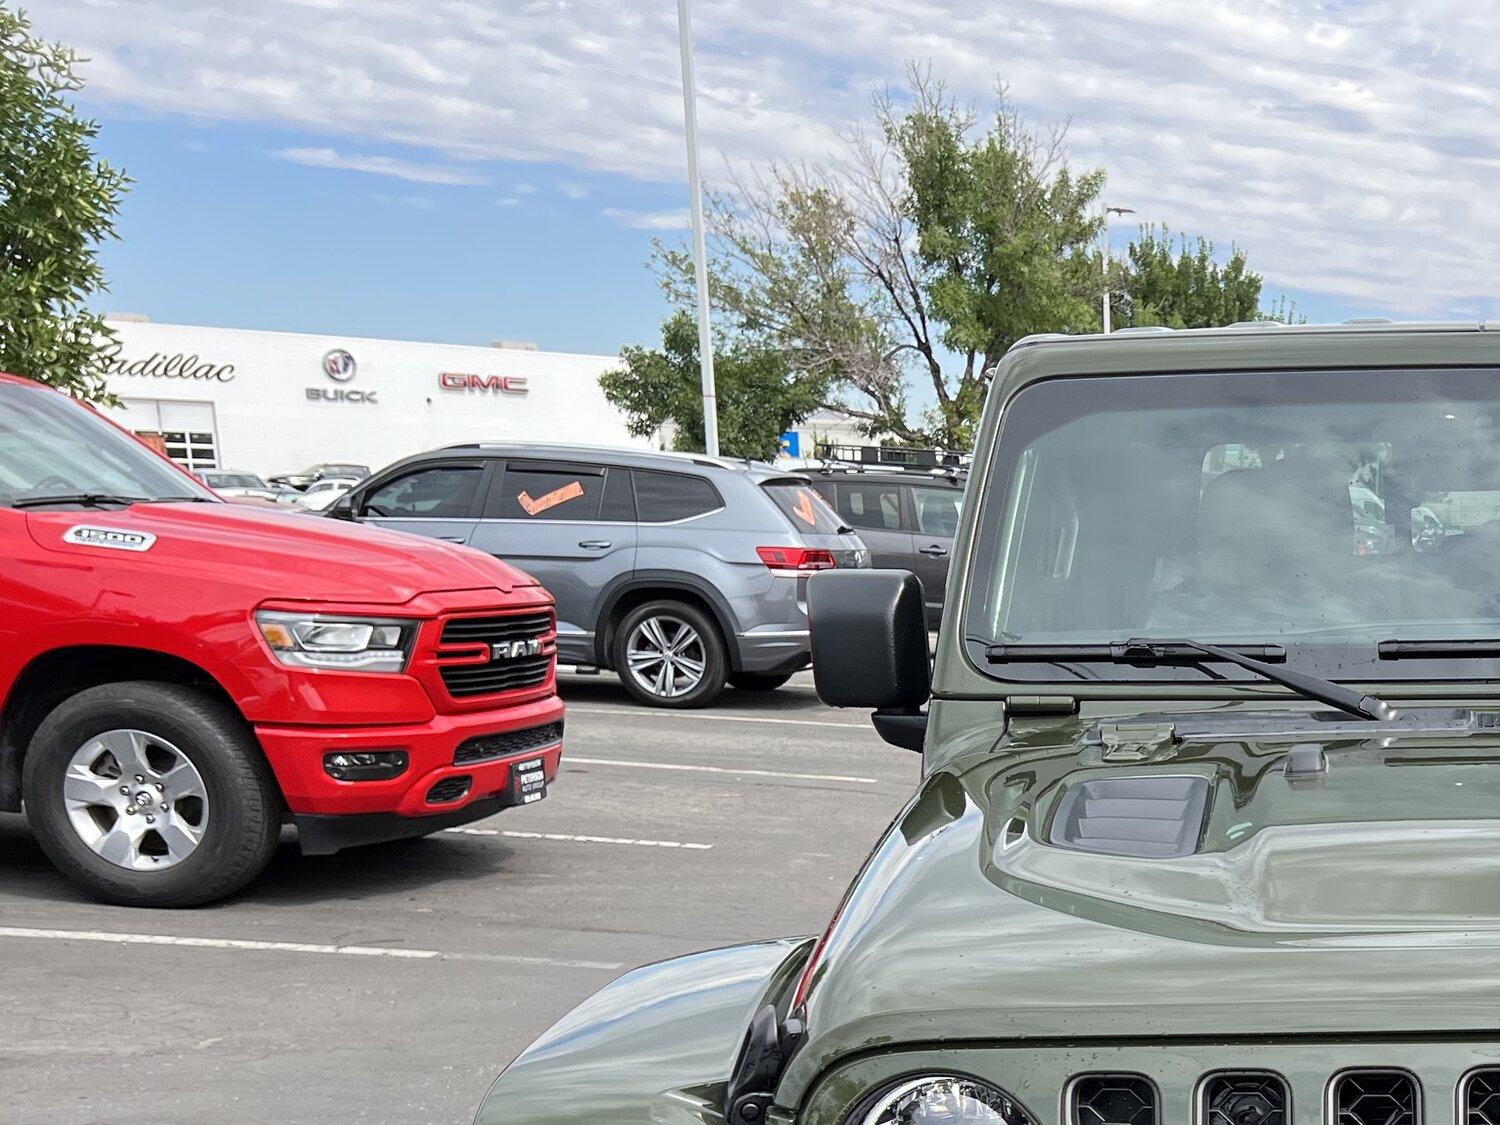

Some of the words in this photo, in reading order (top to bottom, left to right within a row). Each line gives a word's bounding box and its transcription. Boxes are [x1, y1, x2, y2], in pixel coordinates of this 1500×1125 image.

[439, 372, 529, 395] GMC
[305, 386, 378, 404] BUICK
[75, 528, 145, 543] 1500
[492, 639, 542, 660] RAM
